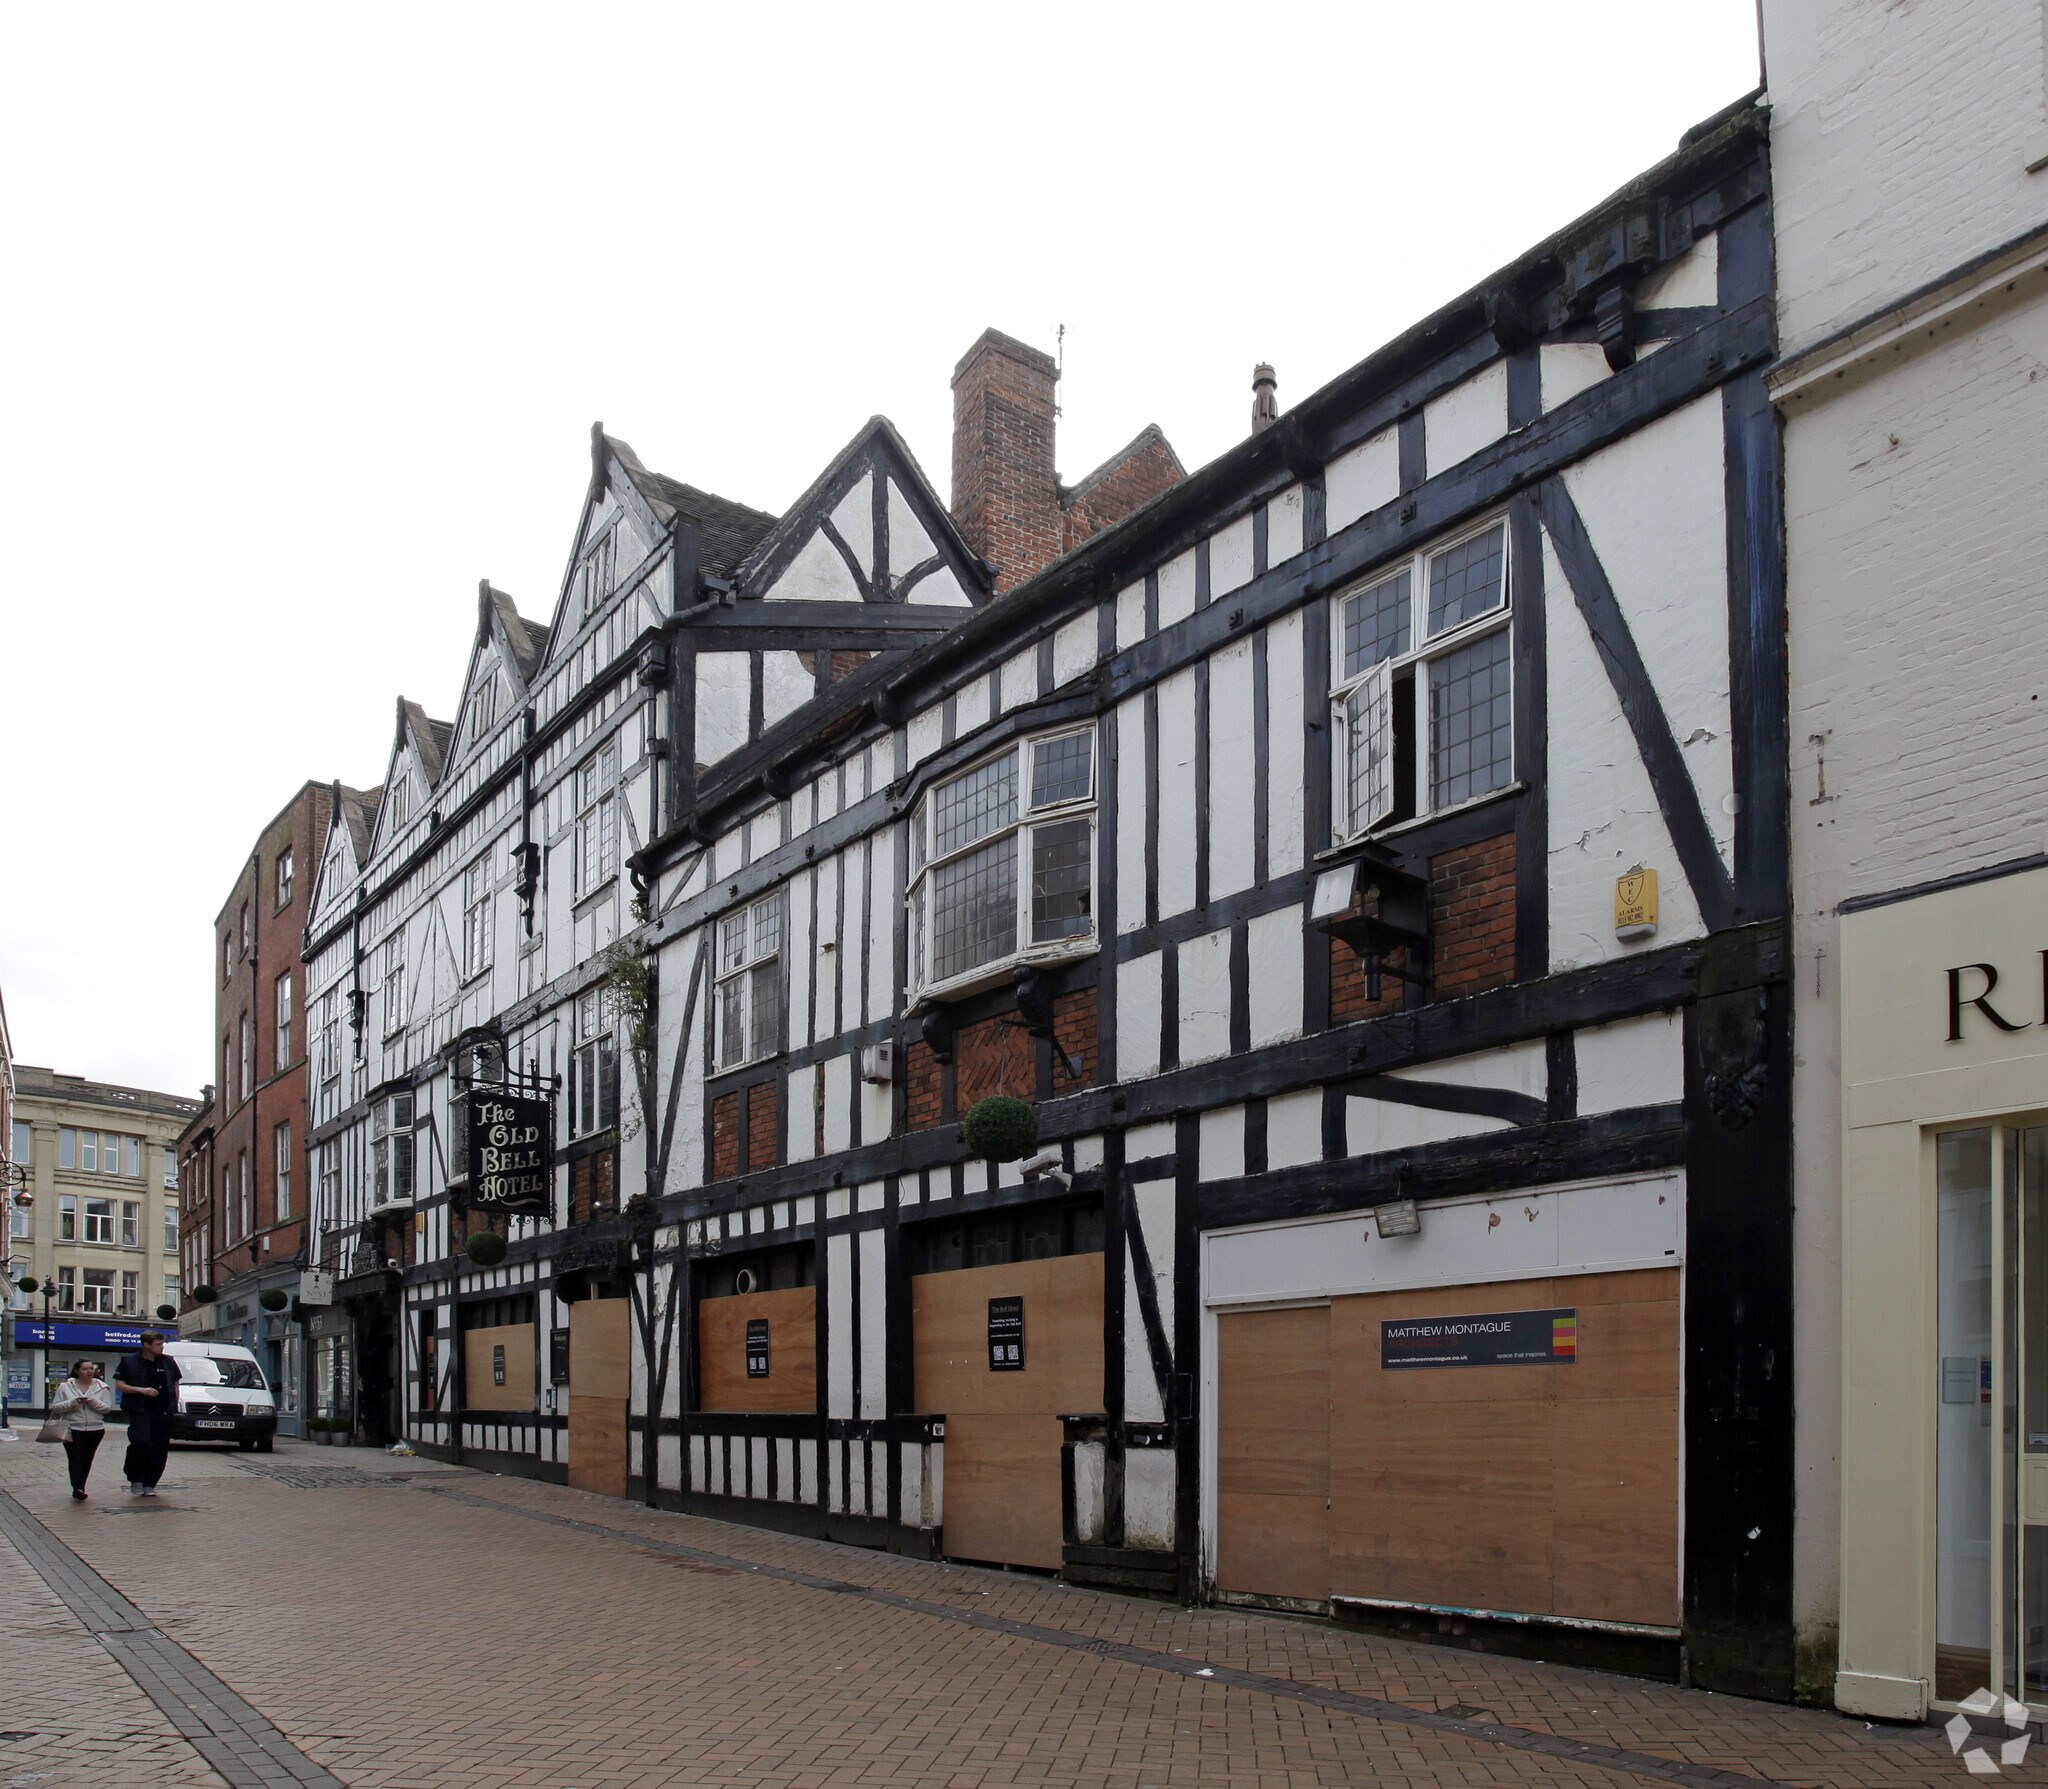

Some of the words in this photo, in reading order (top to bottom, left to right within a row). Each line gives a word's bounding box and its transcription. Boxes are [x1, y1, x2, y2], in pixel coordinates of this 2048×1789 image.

[1619, 906, 1643, 917] ALARMS
[1943, 948, 2048, 1042] R
[475, 1101, 515, 1126] The
[488, 1124, 540, 1147] OLD
[477, 1146, 541, 1178] BELL
[477, 1174, 543, 1202] HOTEL
[1388, 1326, 1442, 1338] MATTHEW
[1445, 1321, 1511, 1335] MONTAGUE
[1388, 1336, 1458, 1349] ARCHITECTS
[1388, 1355, 1468, 1363] www.matthewmontague.co.uk
